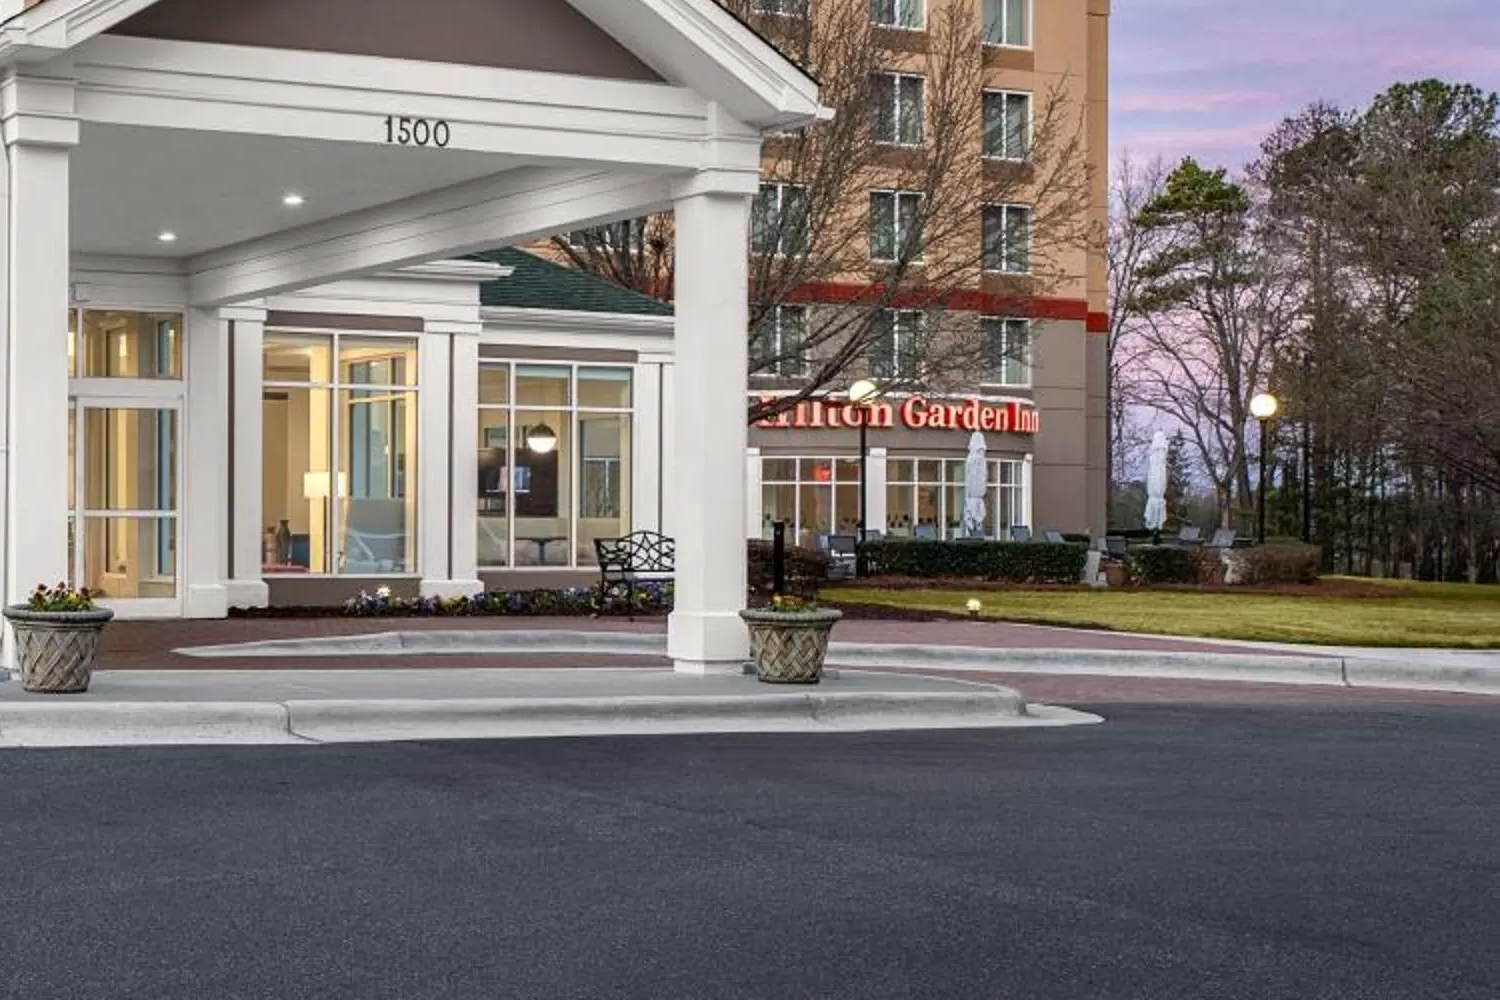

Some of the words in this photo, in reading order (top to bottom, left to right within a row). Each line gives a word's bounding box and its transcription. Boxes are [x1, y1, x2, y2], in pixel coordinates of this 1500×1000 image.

[384, 115, 450, 147] 1500
[901, 393, 1009, 431] Garden
[1012, 401, 1040, 433] Inn
